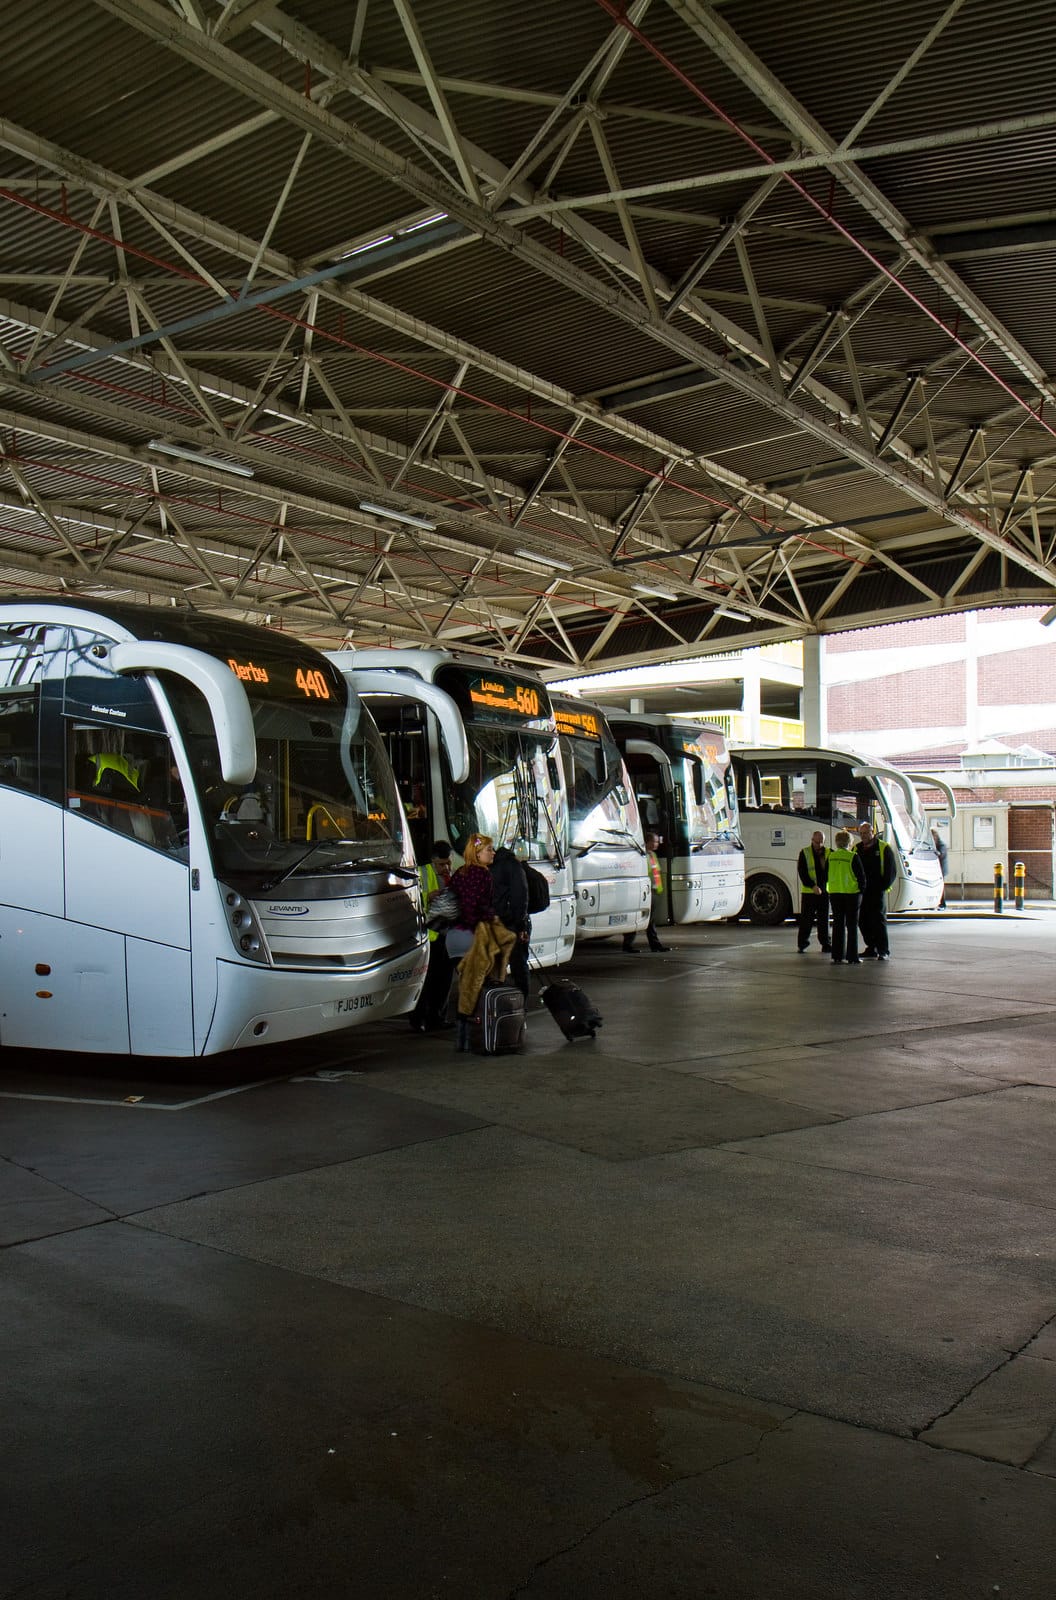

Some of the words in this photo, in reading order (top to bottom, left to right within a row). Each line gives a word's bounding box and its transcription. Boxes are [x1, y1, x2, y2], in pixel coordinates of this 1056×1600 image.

[228, 659, 269, 683] Derby
[296, 668, 330, 699] 440
[481, 678, 505, 694] London
[516, 686, 539, 716] 560
[269, 905, 303, 913] LEVANTE
[337, 997, 359, 1013] FJ09
[360, 993, 374, 1009] DXL
